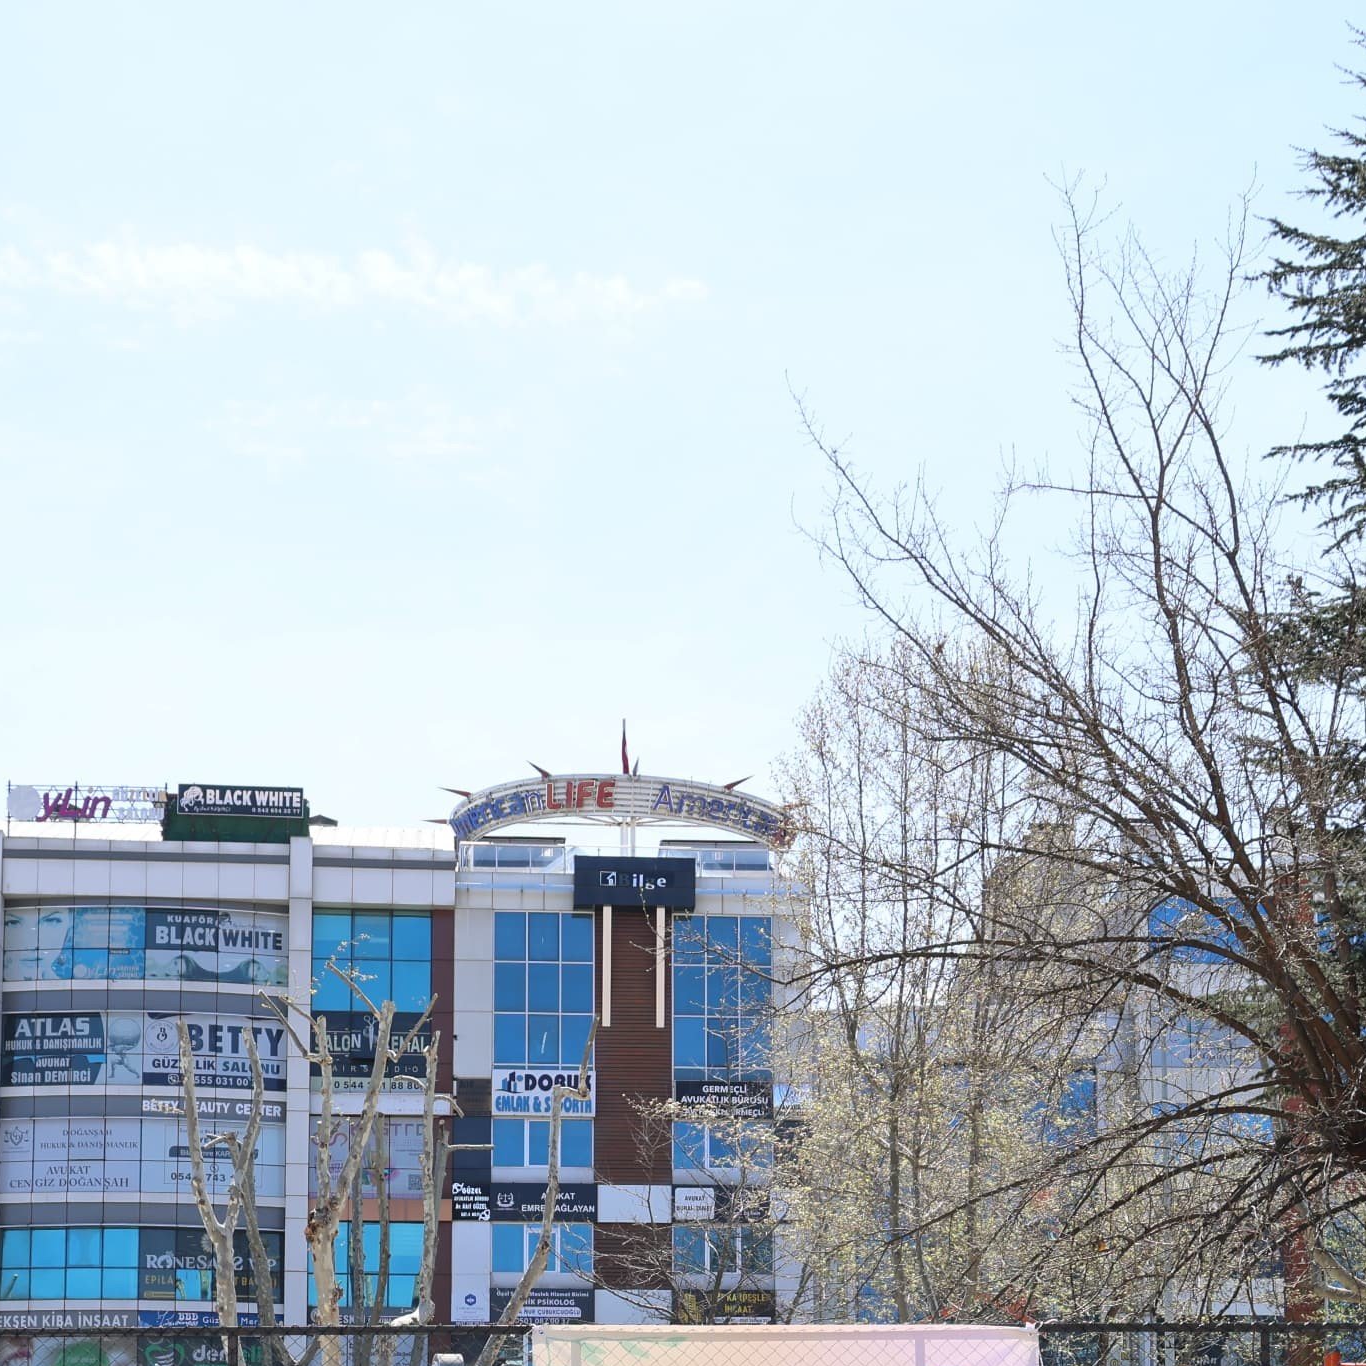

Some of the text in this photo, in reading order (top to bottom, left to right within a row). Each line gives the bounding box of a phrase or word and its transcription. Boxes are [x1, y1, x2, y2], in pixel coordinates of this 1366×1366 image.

[206, 789, 301, 808] BLACK WHITE
[545, 779, 616, 810] LIFE
[166, 914, 213, 925] KUAFÖR
[155, 925, 216, 946] BLACK
[219, 929, 283, 951] WHITE
[14, 1017, 90, 1038] ATLAS
[5, 1040, 33, 1051] HUKUK
[35, 1057, 71, 1068] AVUKAT
[152, 1057, 281, 1076] GÜZLİK SALNU
[215, 1076, 233, 1086] 031
[184, 1102, 231, 1114] EAUTY
[236, 1104, 282, 1117] CETER
[496, 1095, 530, 1113] EMLAK
[533, 1095, 542, 1112] &
[40, 1142, 68, 1150] HUKUK
[46, 1165, 92, 1176] AVUKAT
[9, 1176, 54, 1188] CENGİZ
[541, 1192, 576, 1200] AKAT
[554, 1203, 595, 1213] AĞLAYAN
[537, 1298, 575, 1306] PSİKOLOG
